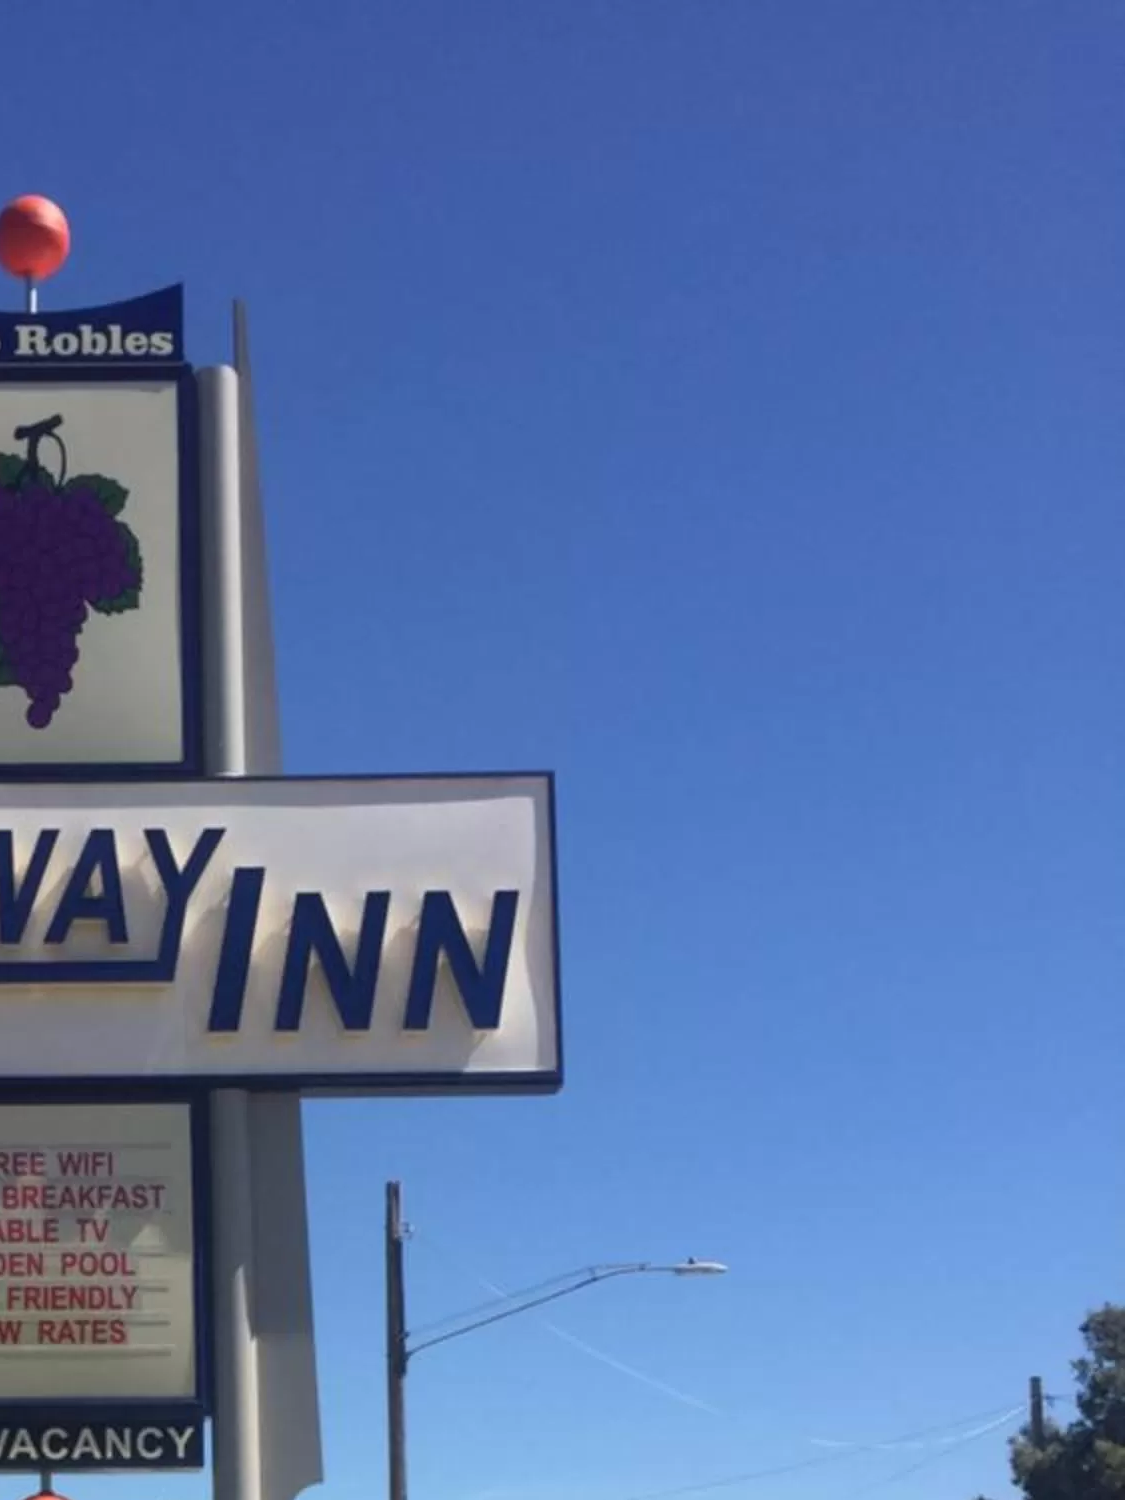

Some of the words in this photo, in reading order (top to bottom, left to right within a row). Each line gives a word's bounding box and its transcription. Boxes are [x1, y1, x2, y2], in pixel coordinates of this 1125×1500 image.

[15, 324, 174, 356] Robles
[207, 866, 520, 1032] INN
[57, 1152, 114, 1176] WIFI
[1, 1185, 166, 1210] BREAKFAST
[77, 1219, 109, 1243] TV
[60, 1252, 135, 1277] POOL
[7, 1286, 139, 1310] FRIENDLY
[37, 1320, 126, 1344] RATES
